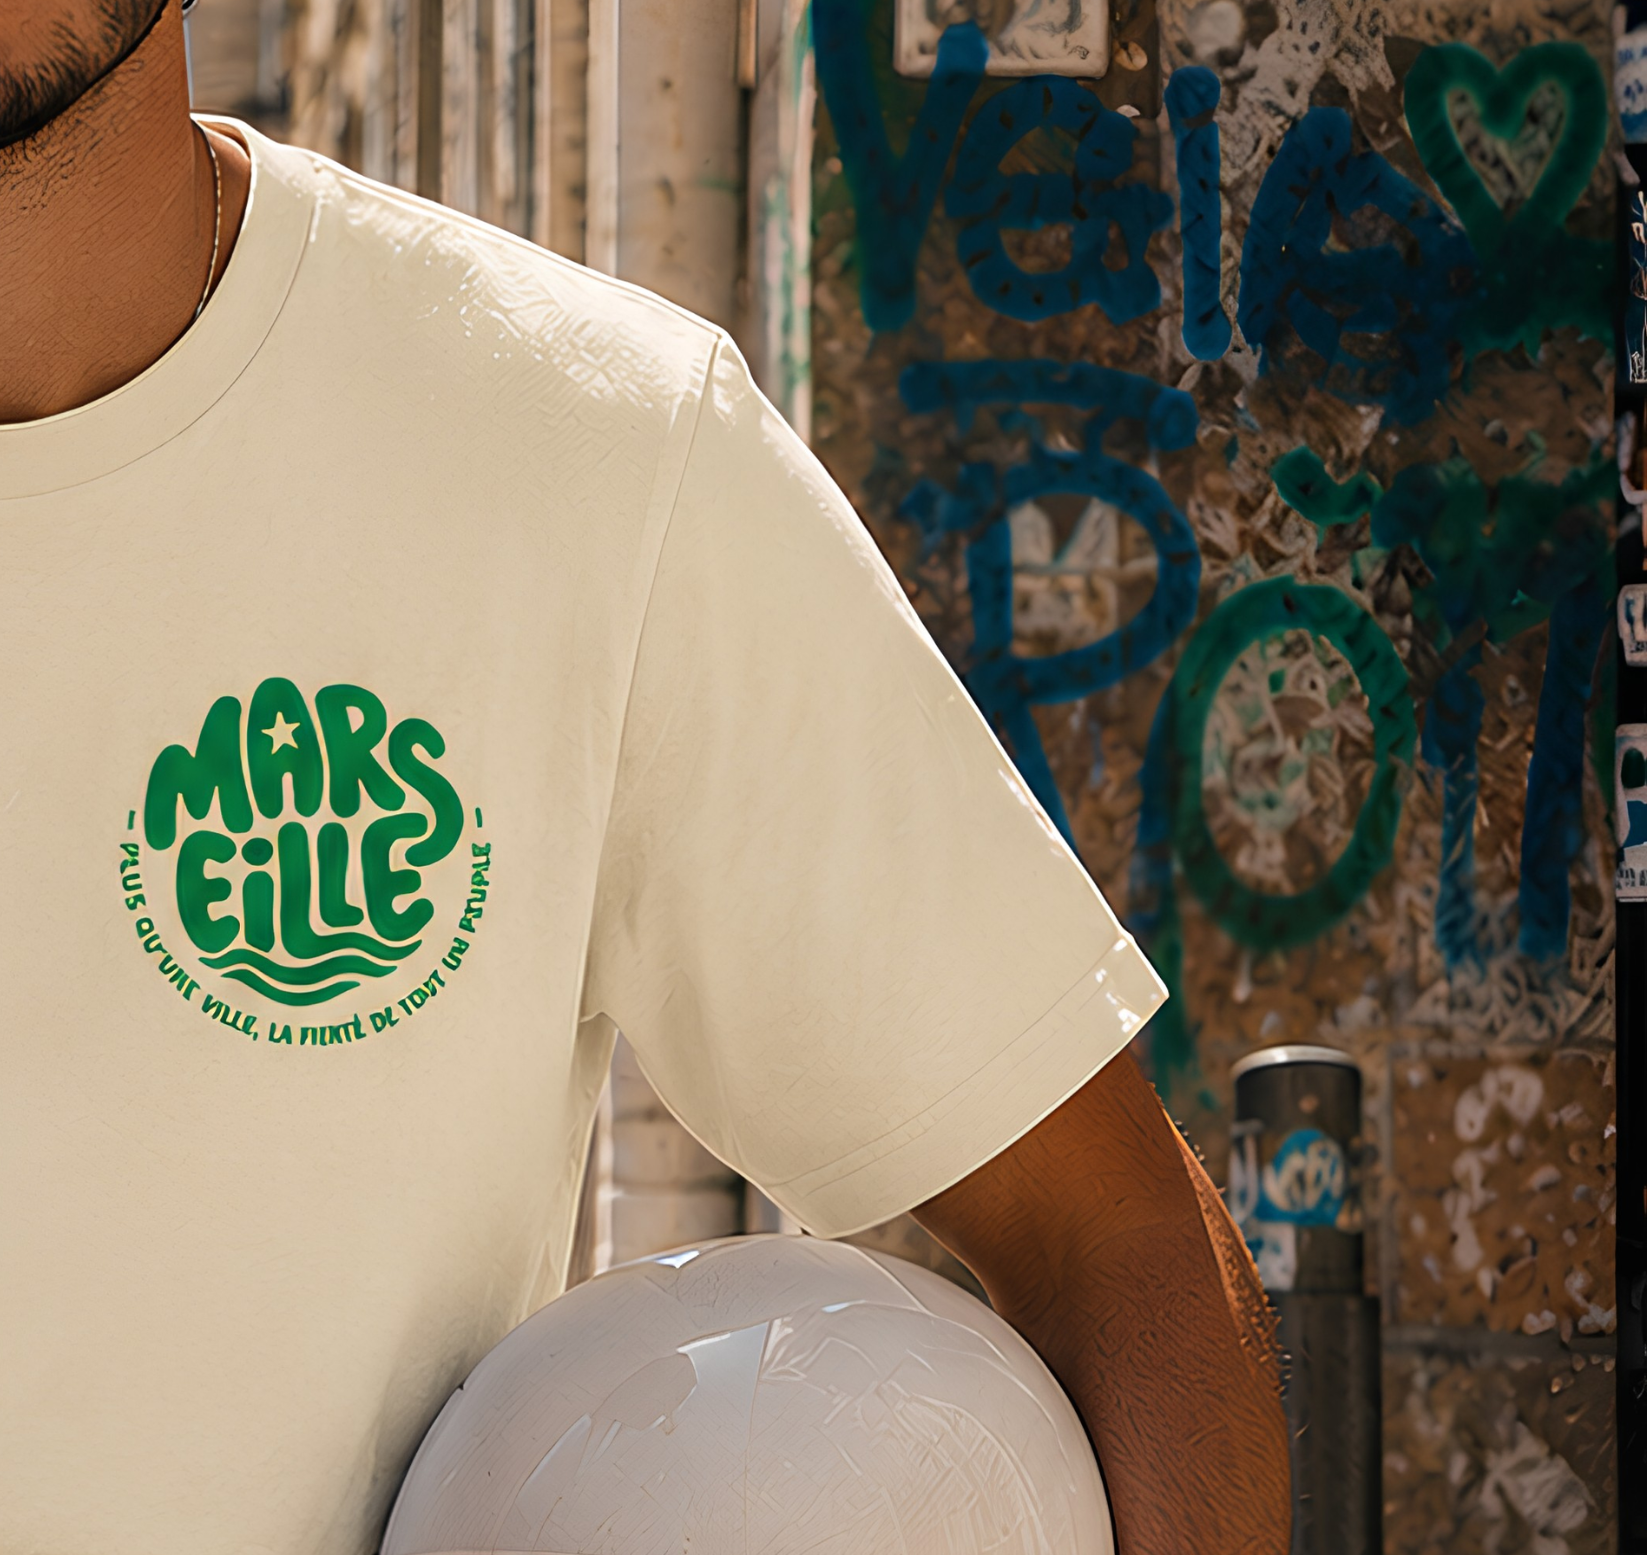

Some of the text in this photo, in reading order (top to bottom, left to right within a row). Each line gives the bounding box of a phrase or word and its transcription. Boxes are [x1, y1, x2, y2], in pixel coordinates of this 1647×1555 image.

[144, 677, 464, 867] MARS
[268, 1021, 293, 1045] LA
[369, 1006, 400, 1034] DE
[441, 936, 470, 972] UN
